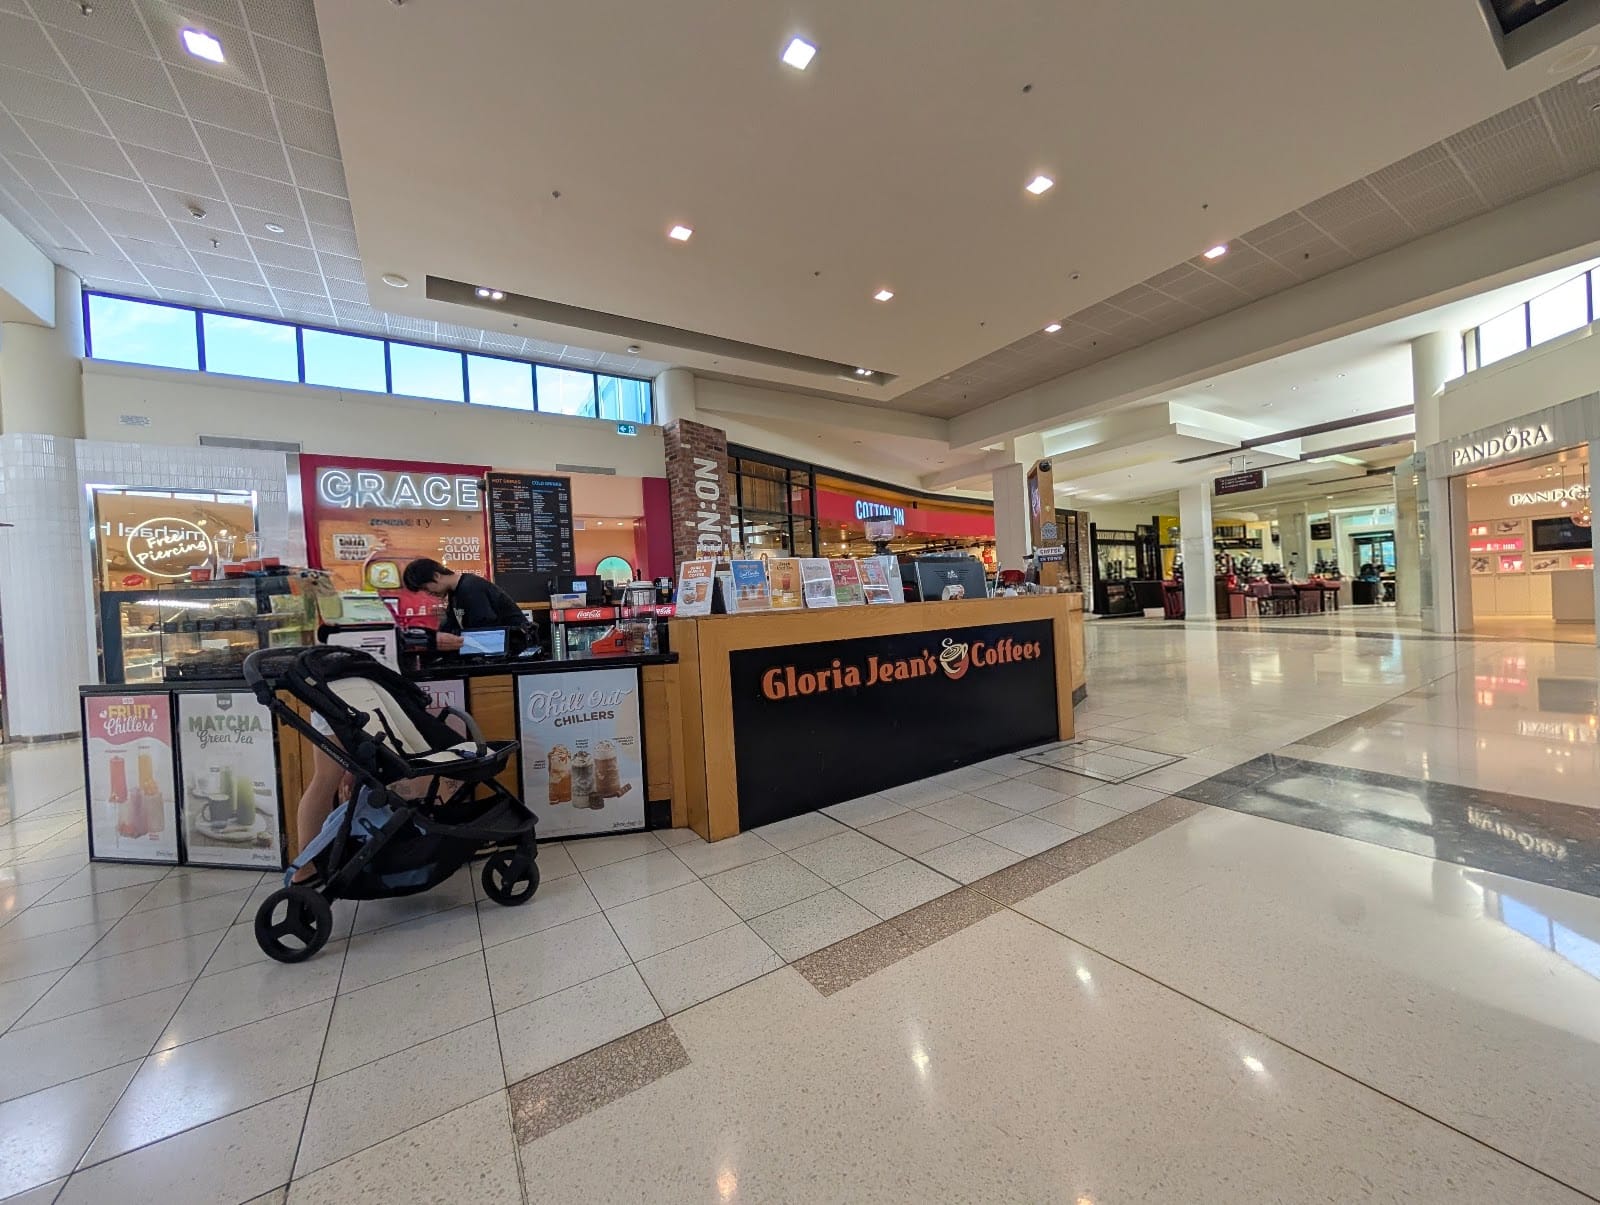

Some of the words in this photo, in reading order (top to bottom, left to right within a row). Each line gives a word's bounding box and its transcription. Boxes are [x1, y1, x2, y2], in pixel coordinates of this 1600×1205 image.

[1452, 424, 1550, 466] PANDORA
[321, 471, 479, 508] GRACE
[856, 500, 891, 520] COTTON
[893, 507, 905, 526] ON
[146, 532, 184, 550] Free
[444, 544, 480, 553] GLOW
[447, 536, 480, 545] YOUR
[136, 540, 207, 565] Piercing
[444, 552, 481, 561] GUIDE
[761, 659, 861, 700] Gloria
[866, 650, 937, 686] Jean's
[971, 638, 1041, 668] Coffees
[108, 703, 151, 720] FRUIT
[527, 688, 585, 723] Chill
[587, 687, 634, 708] Out
[104, 714, 154, 737] Chillers
[188, 714, 263, 733] MATCHA
[554, 710, 615, 728] CHILLERS
[197, 729, 231, 749] Green
[233, 728, 254, 745] Tea
